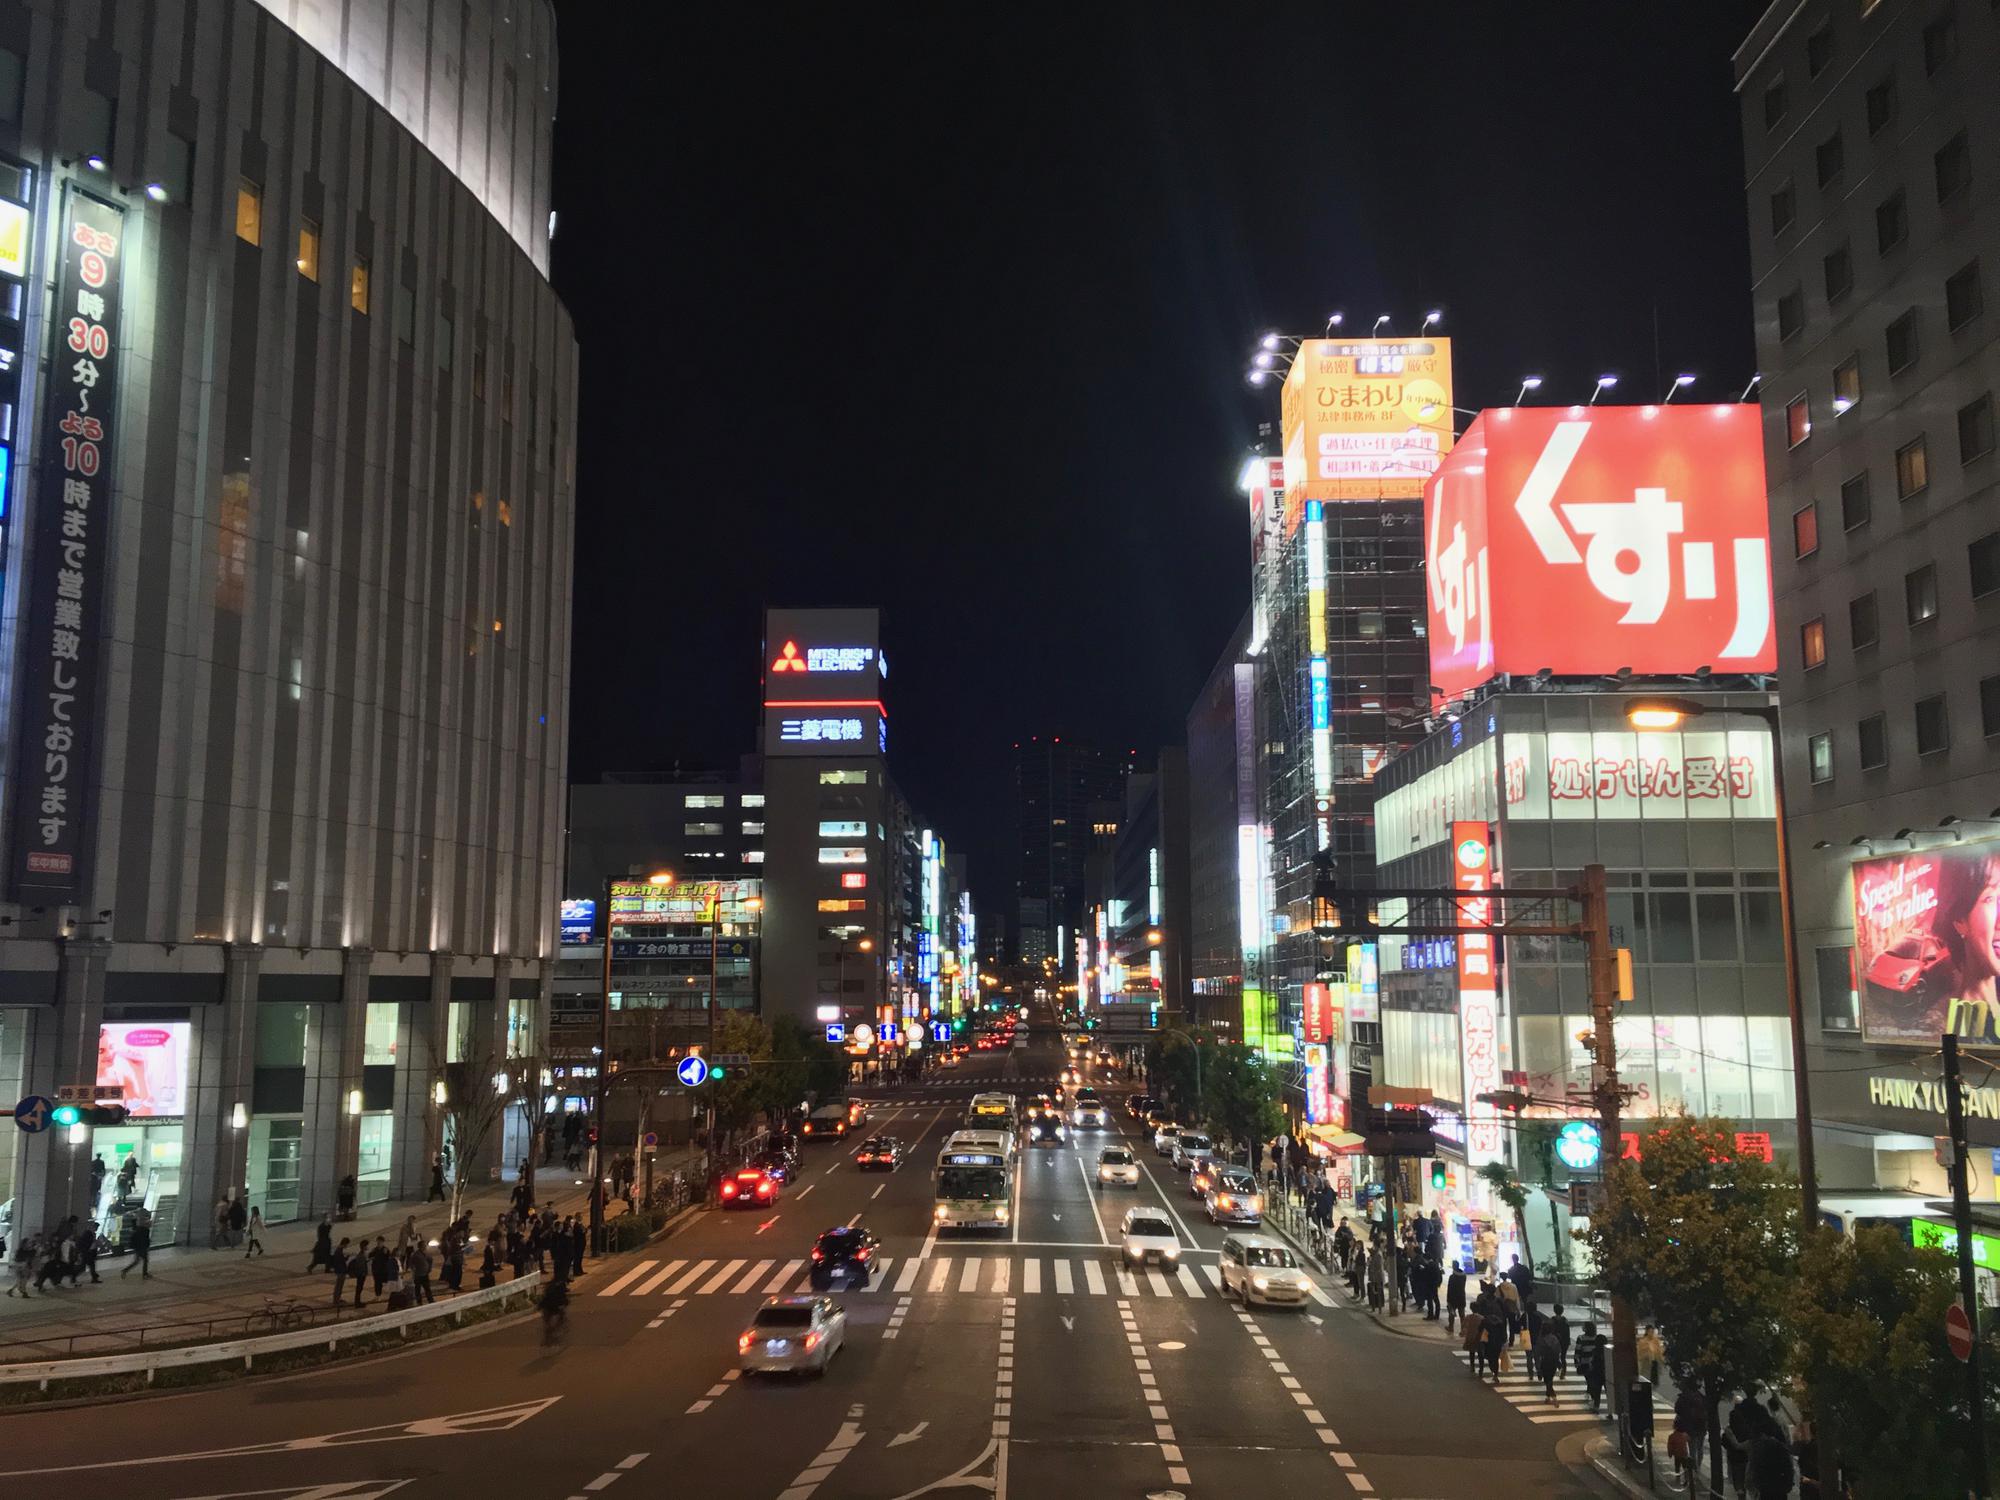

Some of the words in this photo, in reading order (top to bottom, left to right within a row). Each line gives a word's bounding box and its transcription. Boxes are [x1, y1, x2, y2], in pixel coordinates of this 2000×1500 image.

[1317, 384, 1404, 408] ひまわり
[1317, 411, 1376, 422] 法律事務所
[1513, 421, 1771, 658] くすり
[1428, 476, 1488, 672] くすり
[807, 648, 873, 660] MITSUBISHI
[807, 660, 865, 671] ELECTRIC
[780, 718, 863, 741] 三菱電機
[1550, 755, 1754, 800] 処方せん受付
[611, 884, 673, 897] ネットカフェ
[675, 884, 720, 897] ポパイ
[1858, 863, 1904, 919] Speed
[637, 943, 690, 955] Z会の教室
[1945, 996, 2000, 1039] m
[61, 1088, 122, 1100] 時差信号
[1869, 1076, 1948, 1114] HANKYU
[1959, 1084, 2000, 1119] SAN
[1620, 1131, 1774, 1164] ス局
